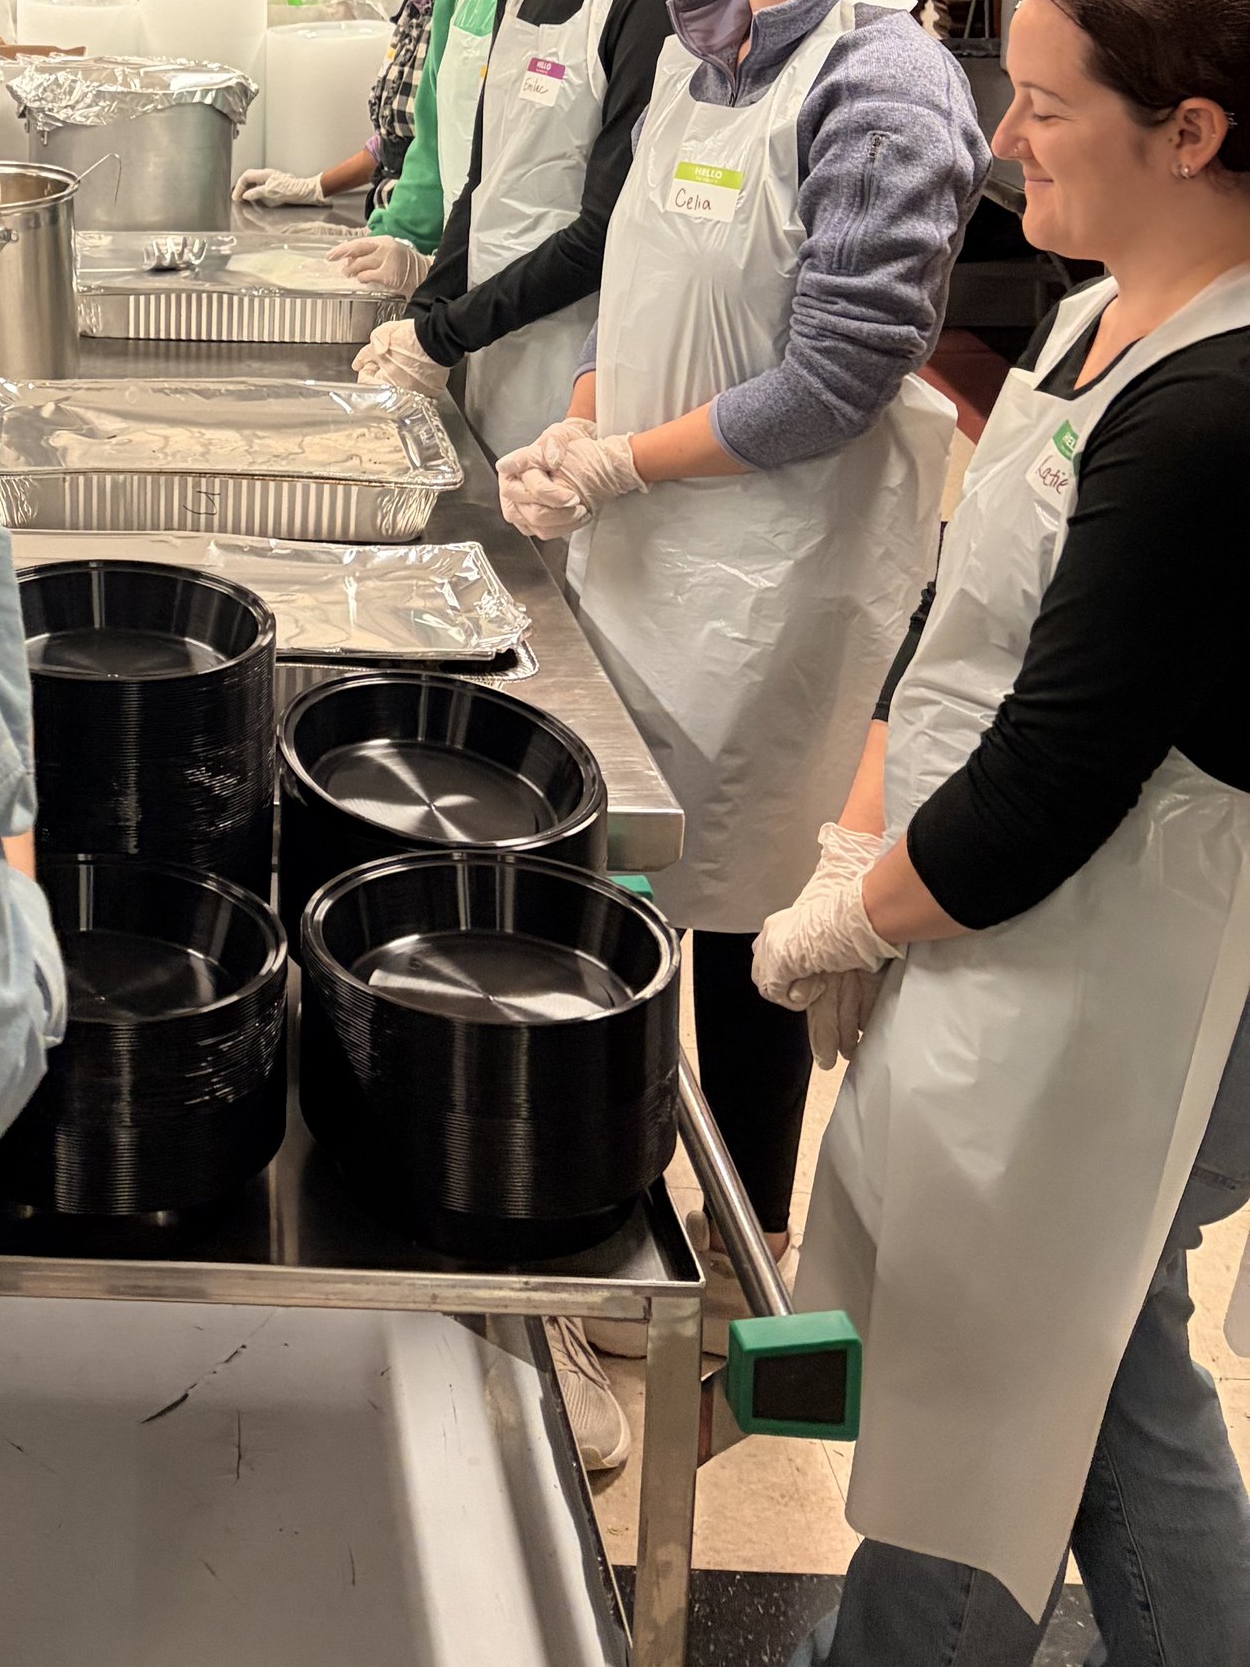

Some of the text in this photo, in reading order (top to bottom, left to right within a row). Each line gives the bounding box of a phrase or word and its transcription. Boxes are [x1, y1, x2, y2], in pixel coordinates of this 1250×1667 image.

[536, 61, 552, 71] HELLO
[695, 166, 723, 179] HELLO
[675, 188, 711, 210] Celia
